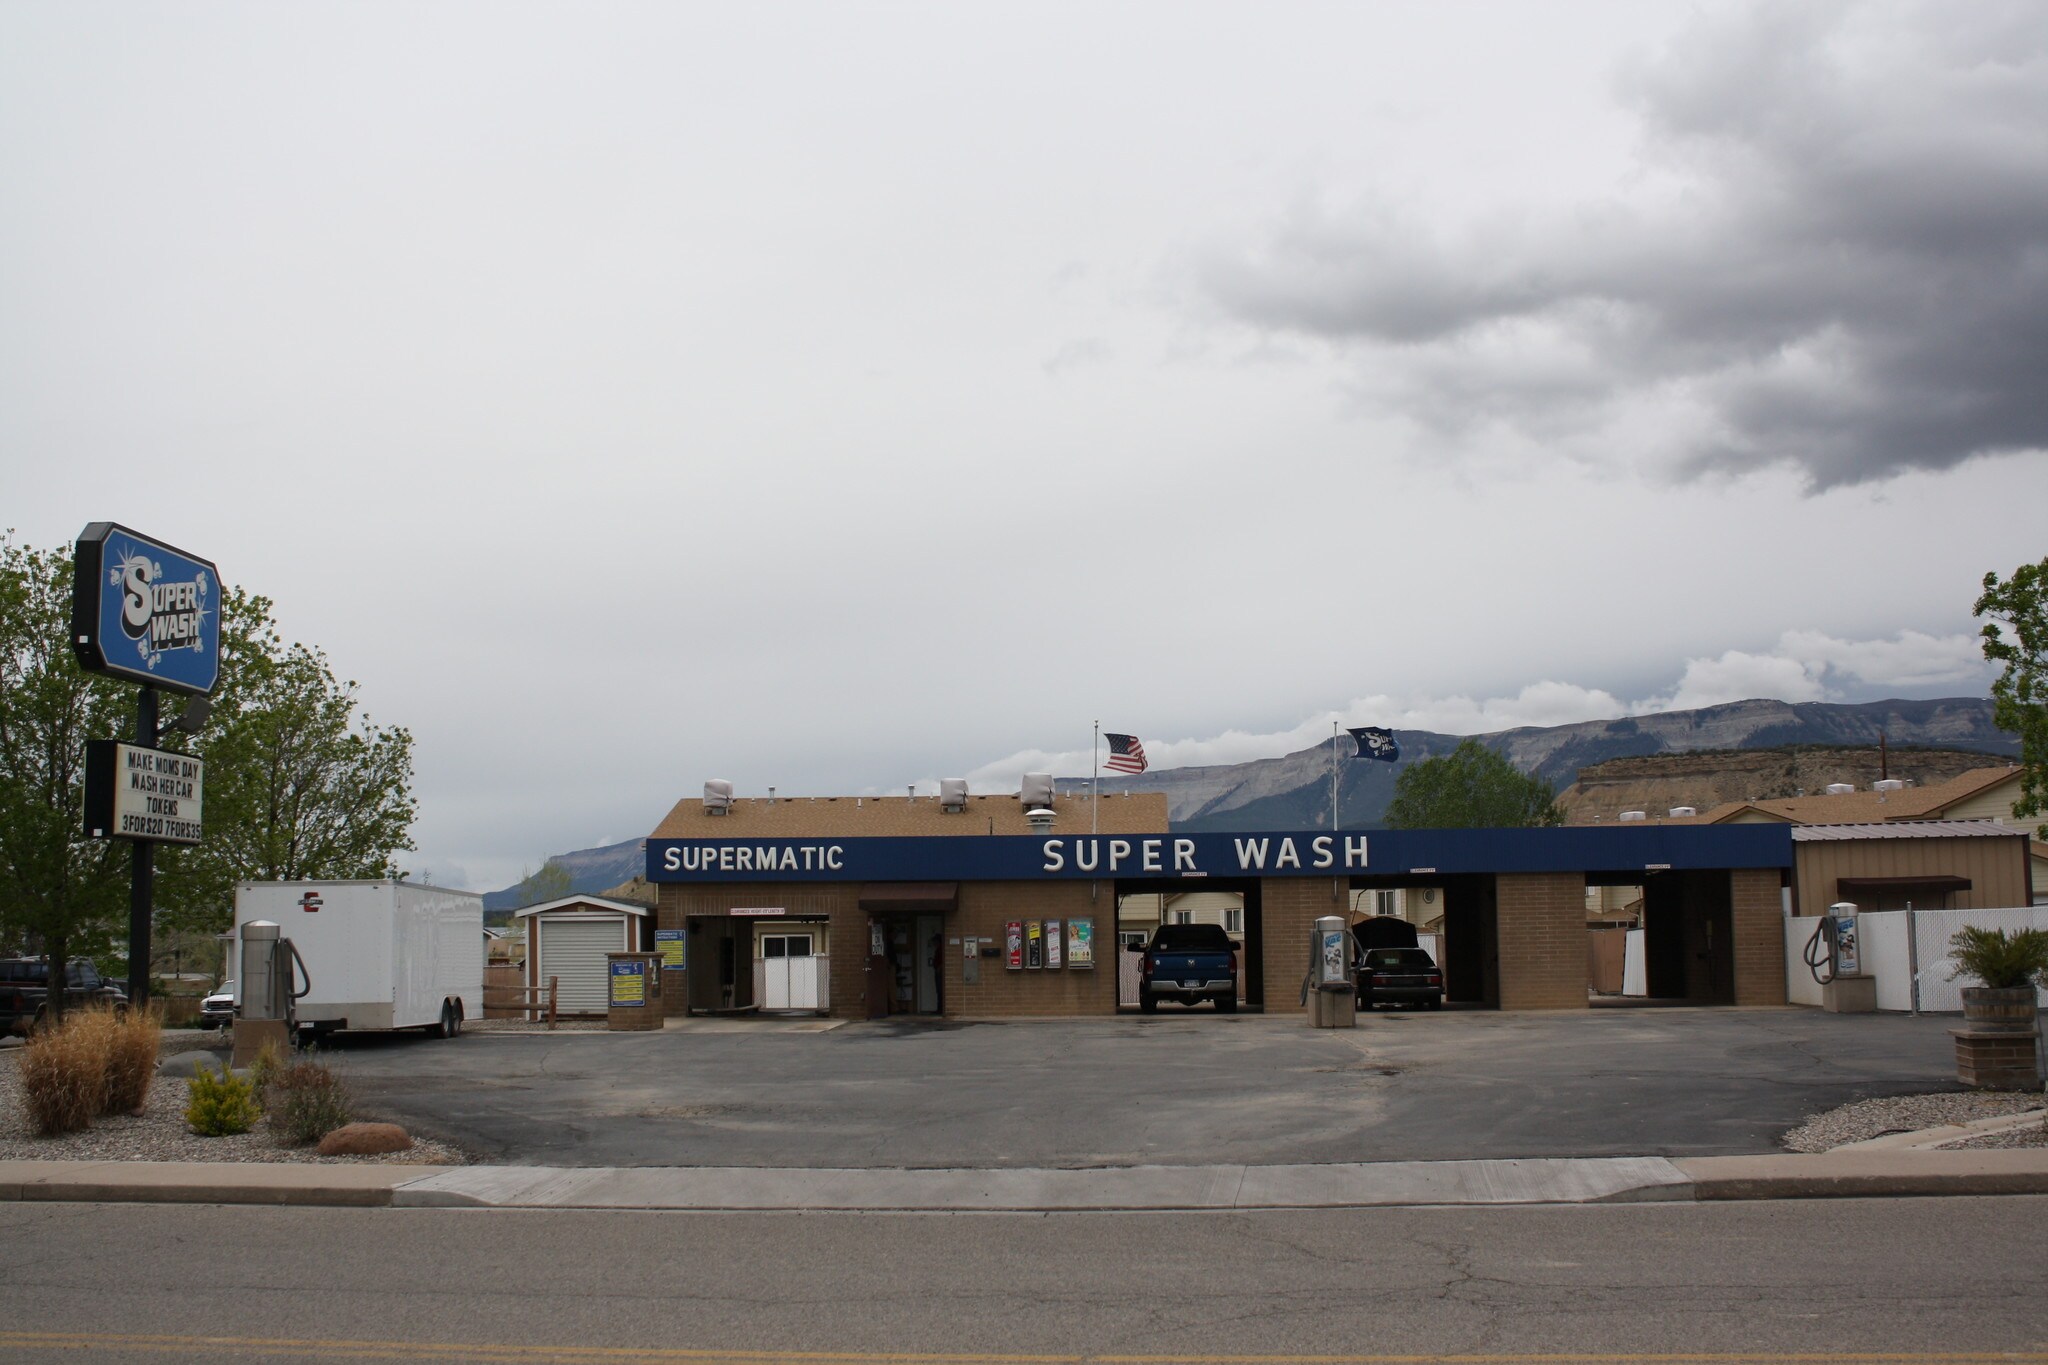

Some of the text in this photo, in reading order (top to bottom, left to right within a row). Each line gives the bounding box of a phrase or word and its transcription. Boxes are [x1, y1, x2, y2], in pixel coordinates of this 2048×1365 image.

[125, 555, 197, 627] SUPER
[151, 612, 199, 642] WASH
[128, 751, 199, 779] MAKE MOMS DAY
[131, 772, 158, 793] WASH
[146, 796, 178, 816] TOKENS
[664, 845, 844, 871] SUPERMATIC
[1043, 836, 1368, 872] SUPER WASH
